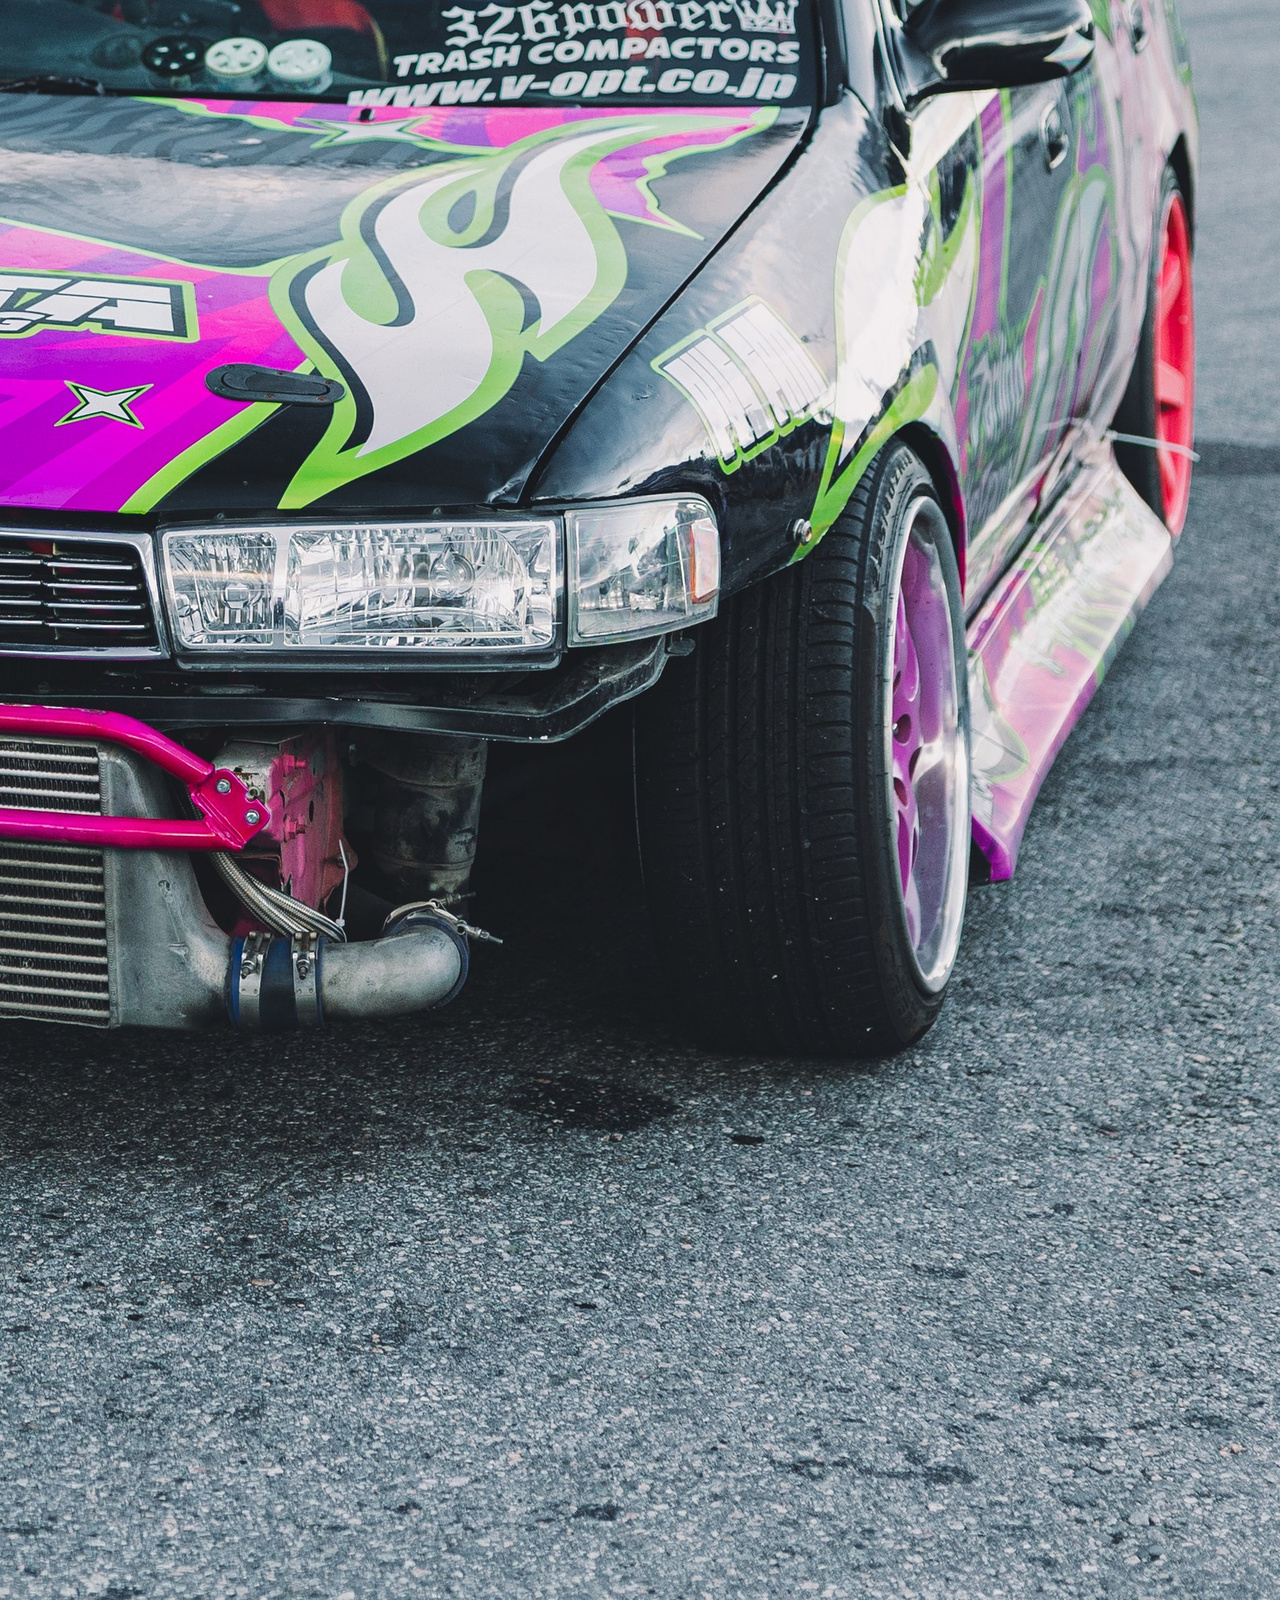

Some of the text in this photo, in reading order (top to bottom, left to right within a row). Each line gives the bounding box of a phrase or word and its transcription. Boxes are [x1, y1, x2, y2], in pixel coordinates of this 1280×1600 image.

[392, 36, 802, 78] TRASH COMPACTORS
[346, 66, 800, 108] www.v-opt.co.jp
